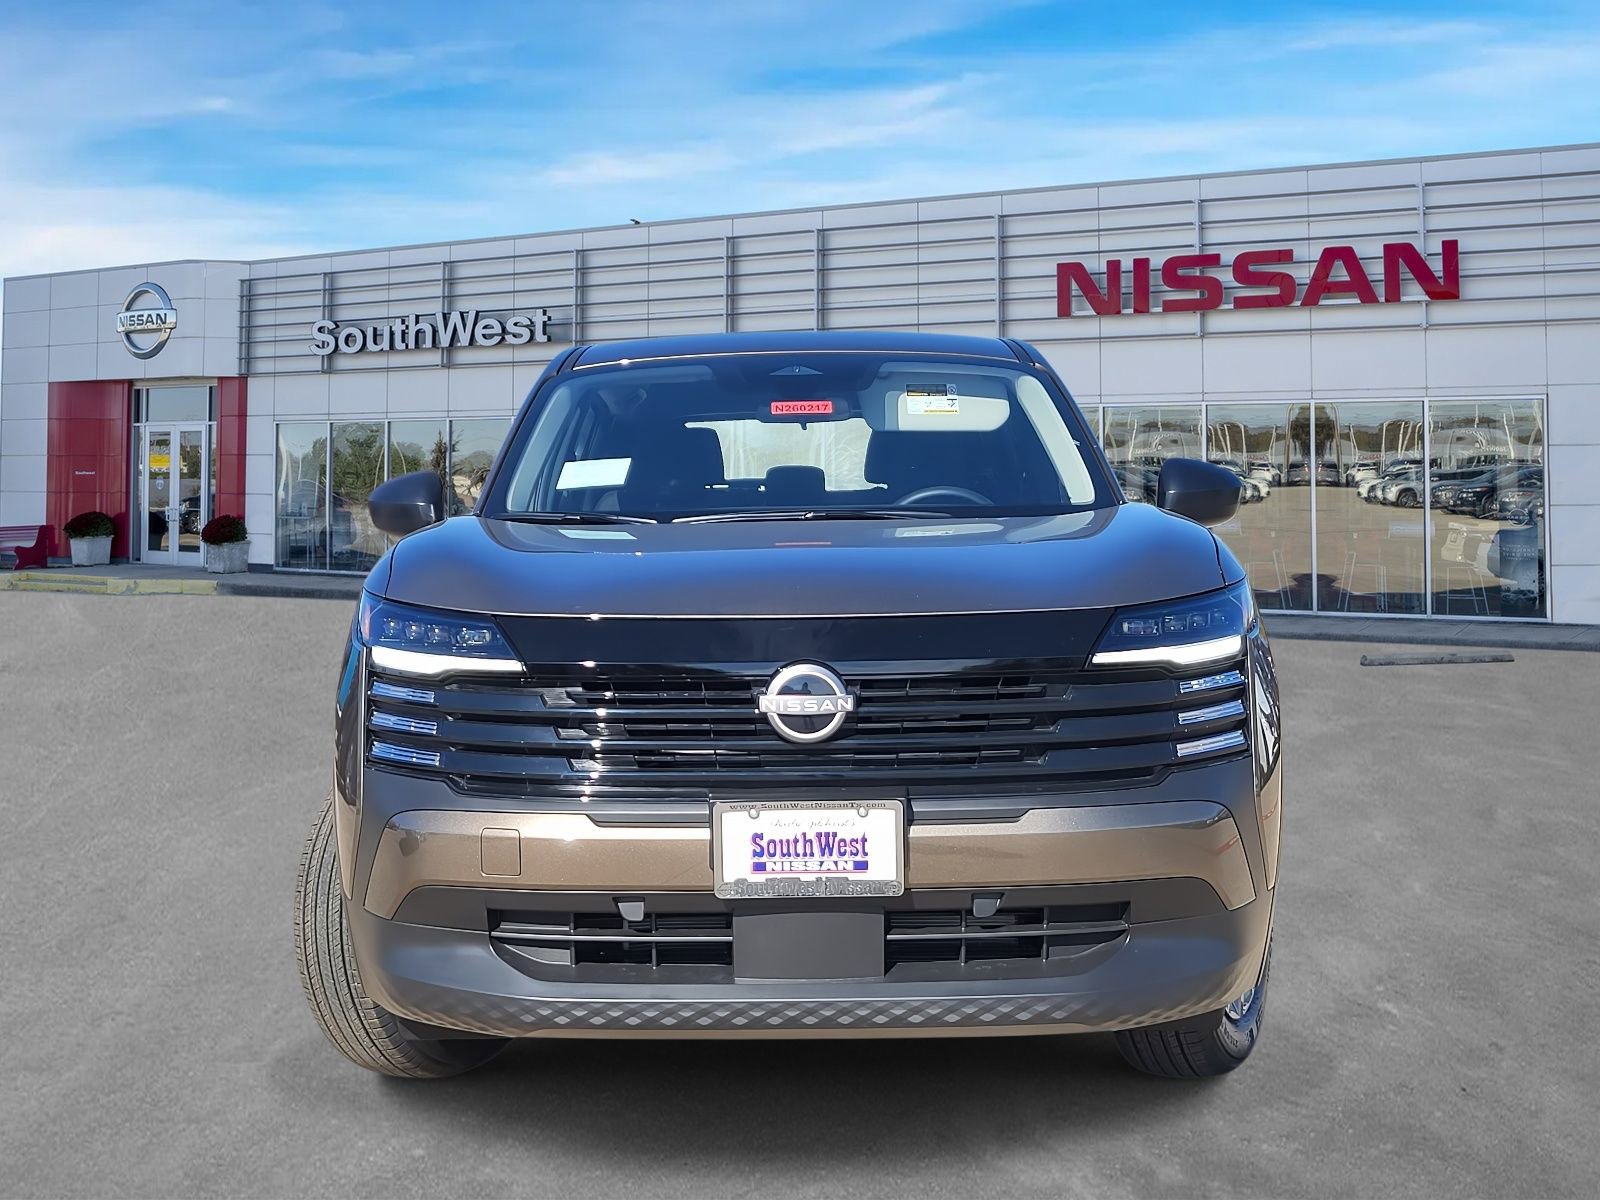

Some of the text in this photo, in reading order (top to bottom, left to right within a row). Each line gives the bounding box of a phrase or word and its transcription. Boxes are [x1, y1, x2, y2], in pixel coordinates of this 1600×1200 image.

[1056, 239, 1462, 318] NISSAN
[118, 312, 168, 328] NISSAN
[309, 308, 551, 356] SouthWest
[774, 403, 829, 413] N260217
[761, 697, 853, 713] NISSAN
[750, 831, 869, 859] SouthWest
[765, 861, 855, 871] NISSAN
